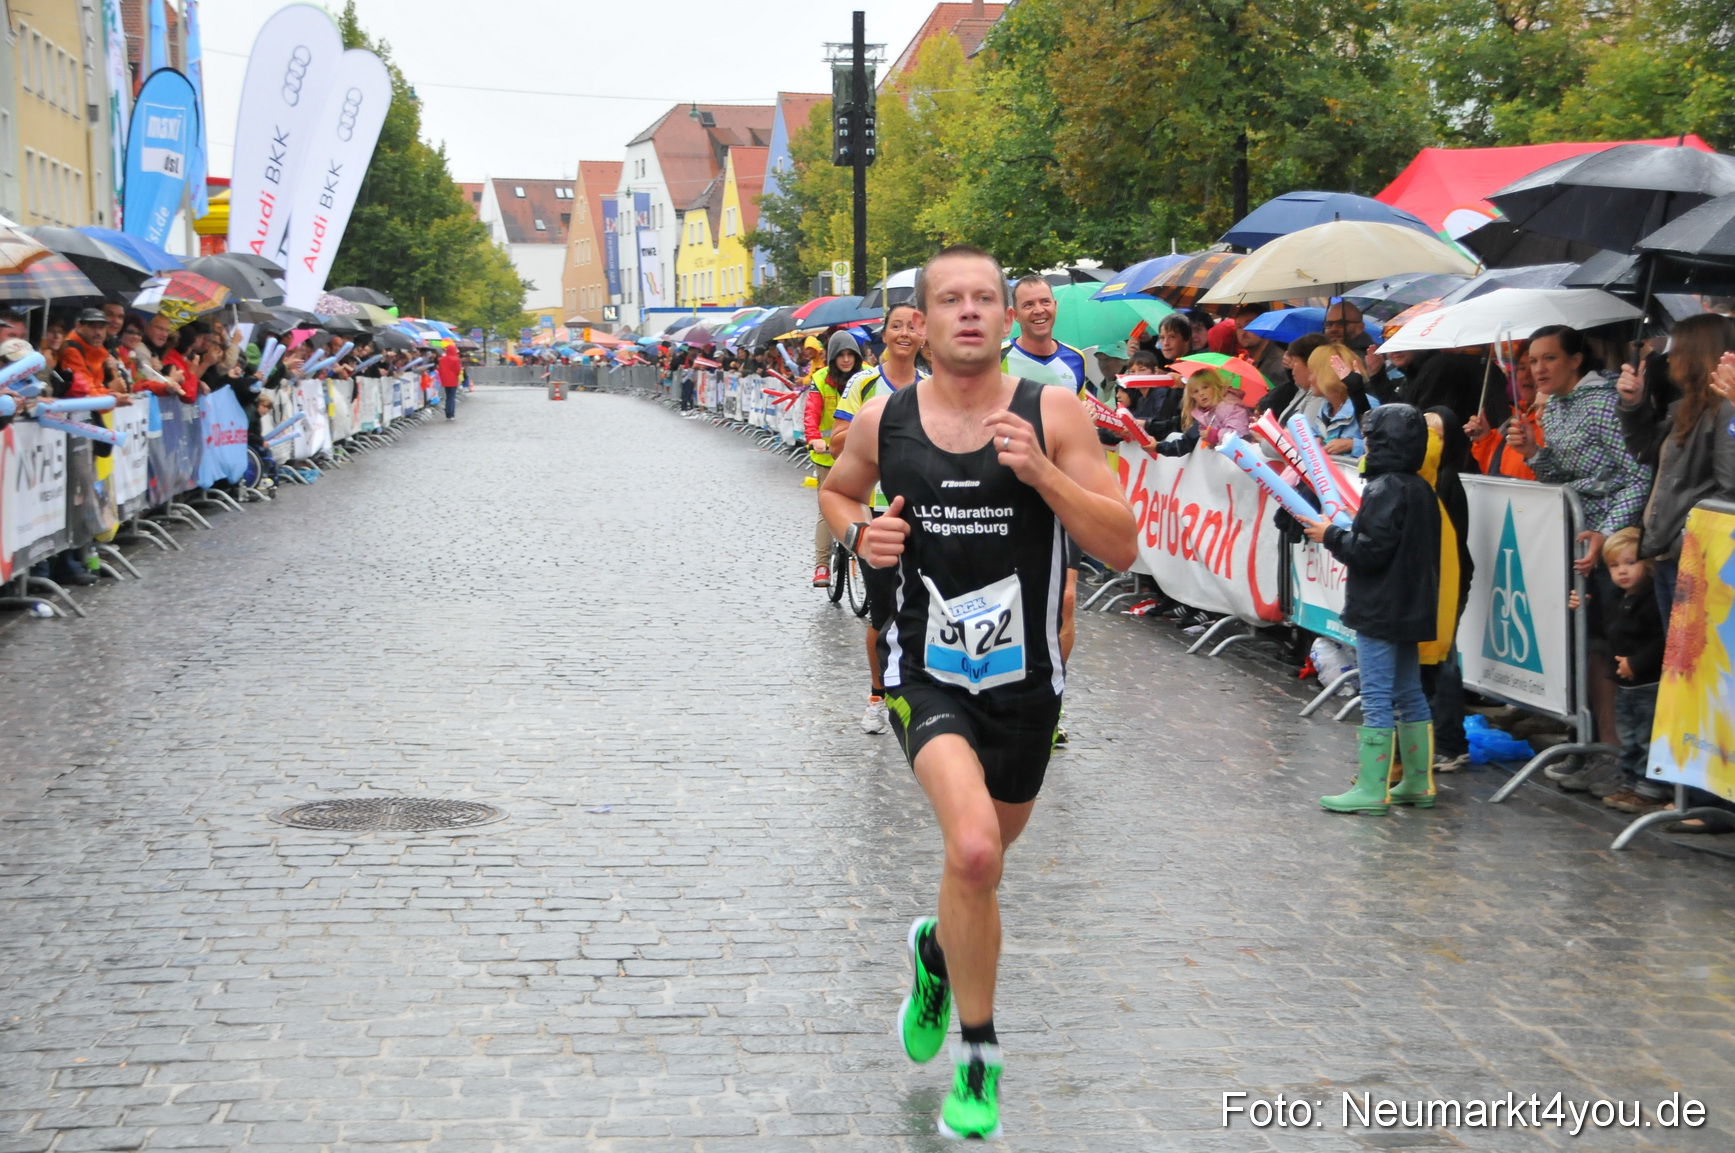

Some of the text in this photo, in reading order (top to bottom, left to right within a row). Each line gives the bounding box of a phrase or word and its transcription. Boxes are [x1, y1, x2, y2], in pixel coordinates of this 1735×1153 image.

[250, 124, 290, 256] Audi BKK
[303, 158, 343, 273] Audi BKK
[922, 521, 1009, 537] Regensburg
[944, 506, 1014, 519] Marathon
[1118, 456, 1242, 580] berbank
